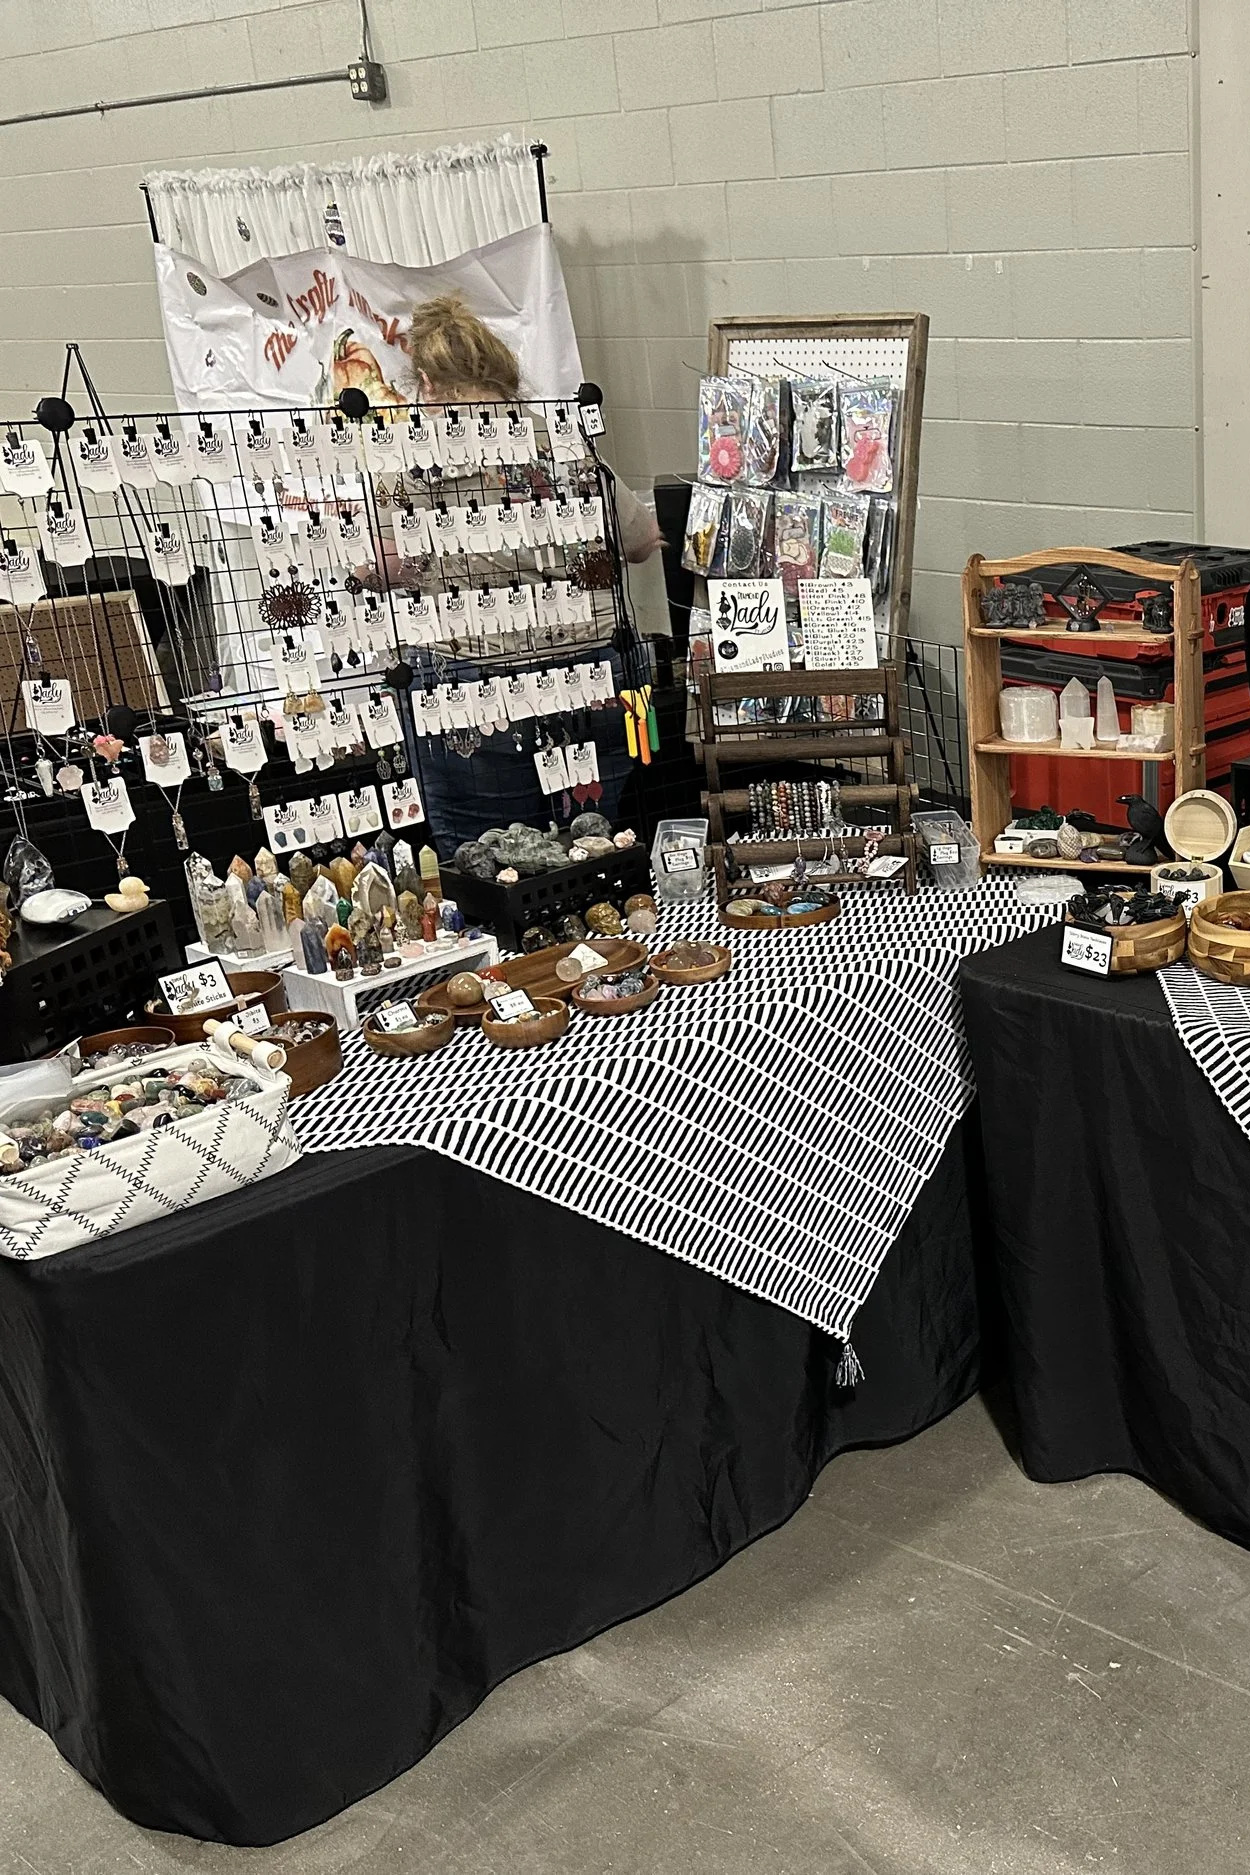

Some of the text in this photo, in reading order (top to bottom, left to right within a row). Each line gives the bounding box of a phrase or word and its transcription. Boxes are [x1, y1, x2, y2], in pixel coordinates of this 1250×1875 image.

[730, 590, 778, 636] Lady
[1184, 889, 1198, 903] $3
[1085, 944, 1107, 967] $23
[199, 972, 217, 987] $3
[206, 992, 226, 1003] Sticks
